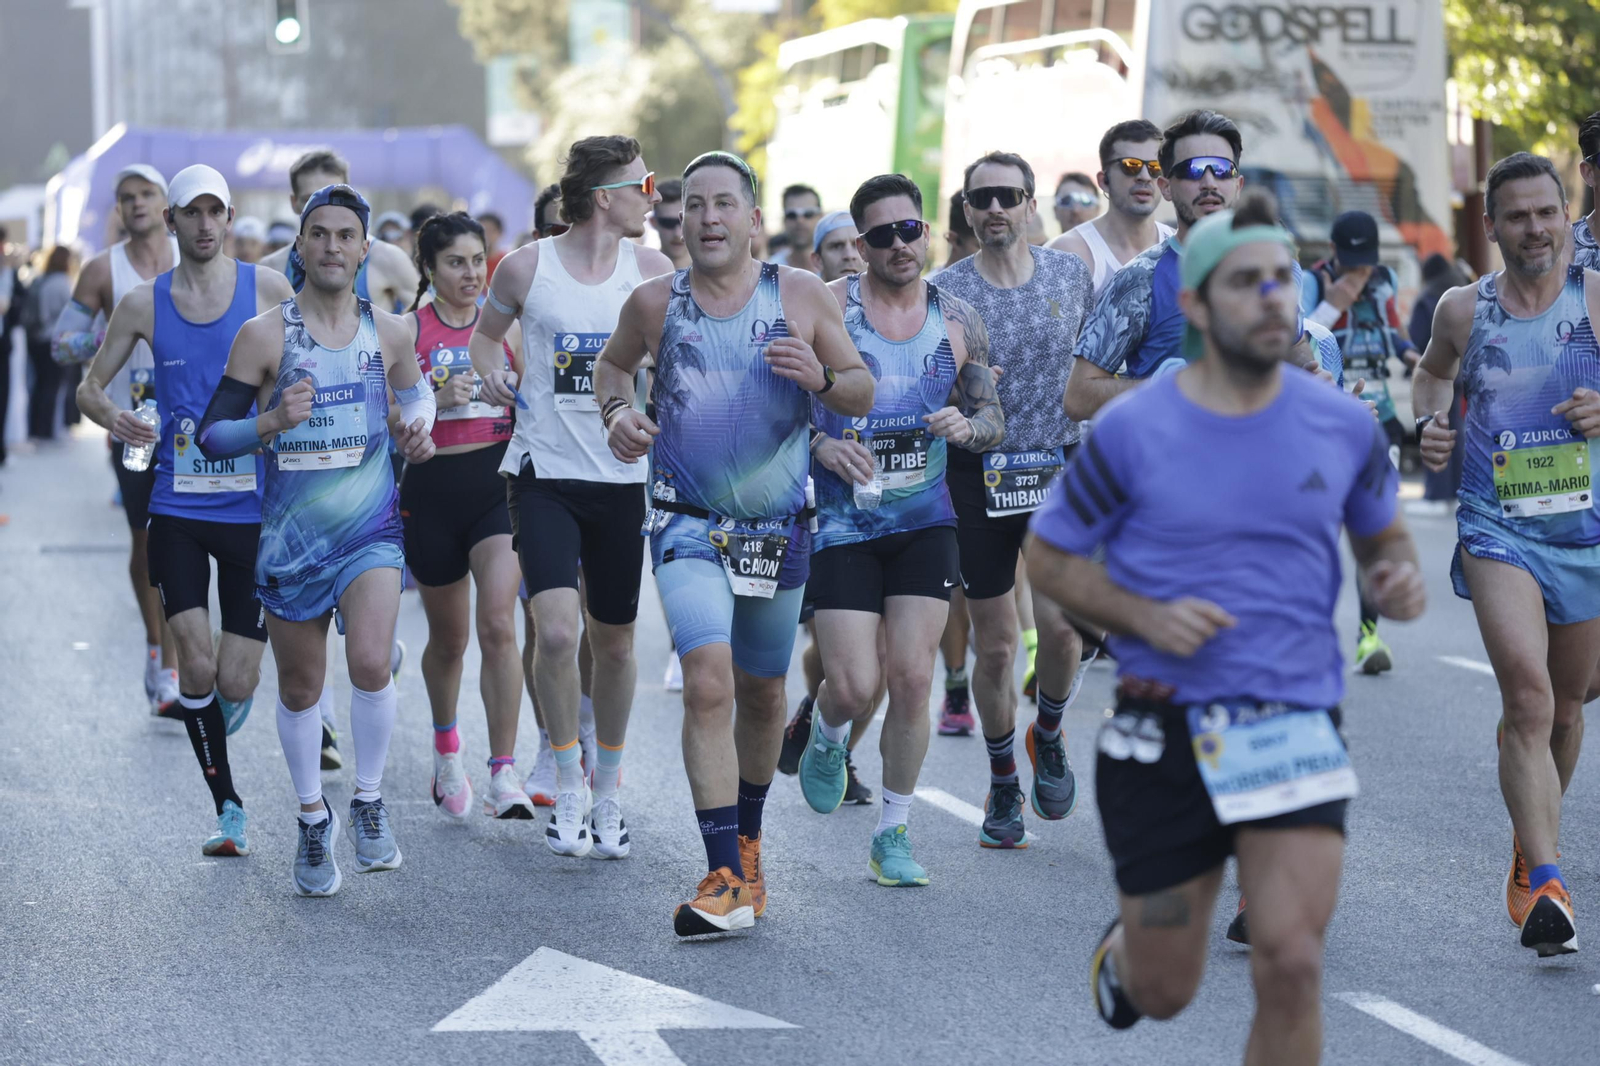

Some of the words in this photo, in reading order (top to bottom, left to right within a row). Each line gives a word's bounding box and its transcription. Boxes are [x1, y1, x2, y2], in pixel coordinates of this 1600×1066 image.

[1181, 4, 1415, 46] GODSPELL
[311, 389, 353, 404] URICH
[309, 416, 335, 428] 6315
[871, 415, 916, 429] ZURICH
[278, 434, 367, 452] MARTINA-MATEO
[1522, 429, 1573, 444] ZURICH
[891, 452, 926, 470] PIBE
[1013, 452, 1055, 464] ZURICH
[1526, 456, 1554, 469] 1922
[193, 459, 235, 473] STIJN
[1015, 475, 1039, 487] 3737
[1496, 475, 1590, 497] FÁTIMA-MARIO
[992, 488, 1051, 508] THIBAU
[743, 541, 764, 552] 418
